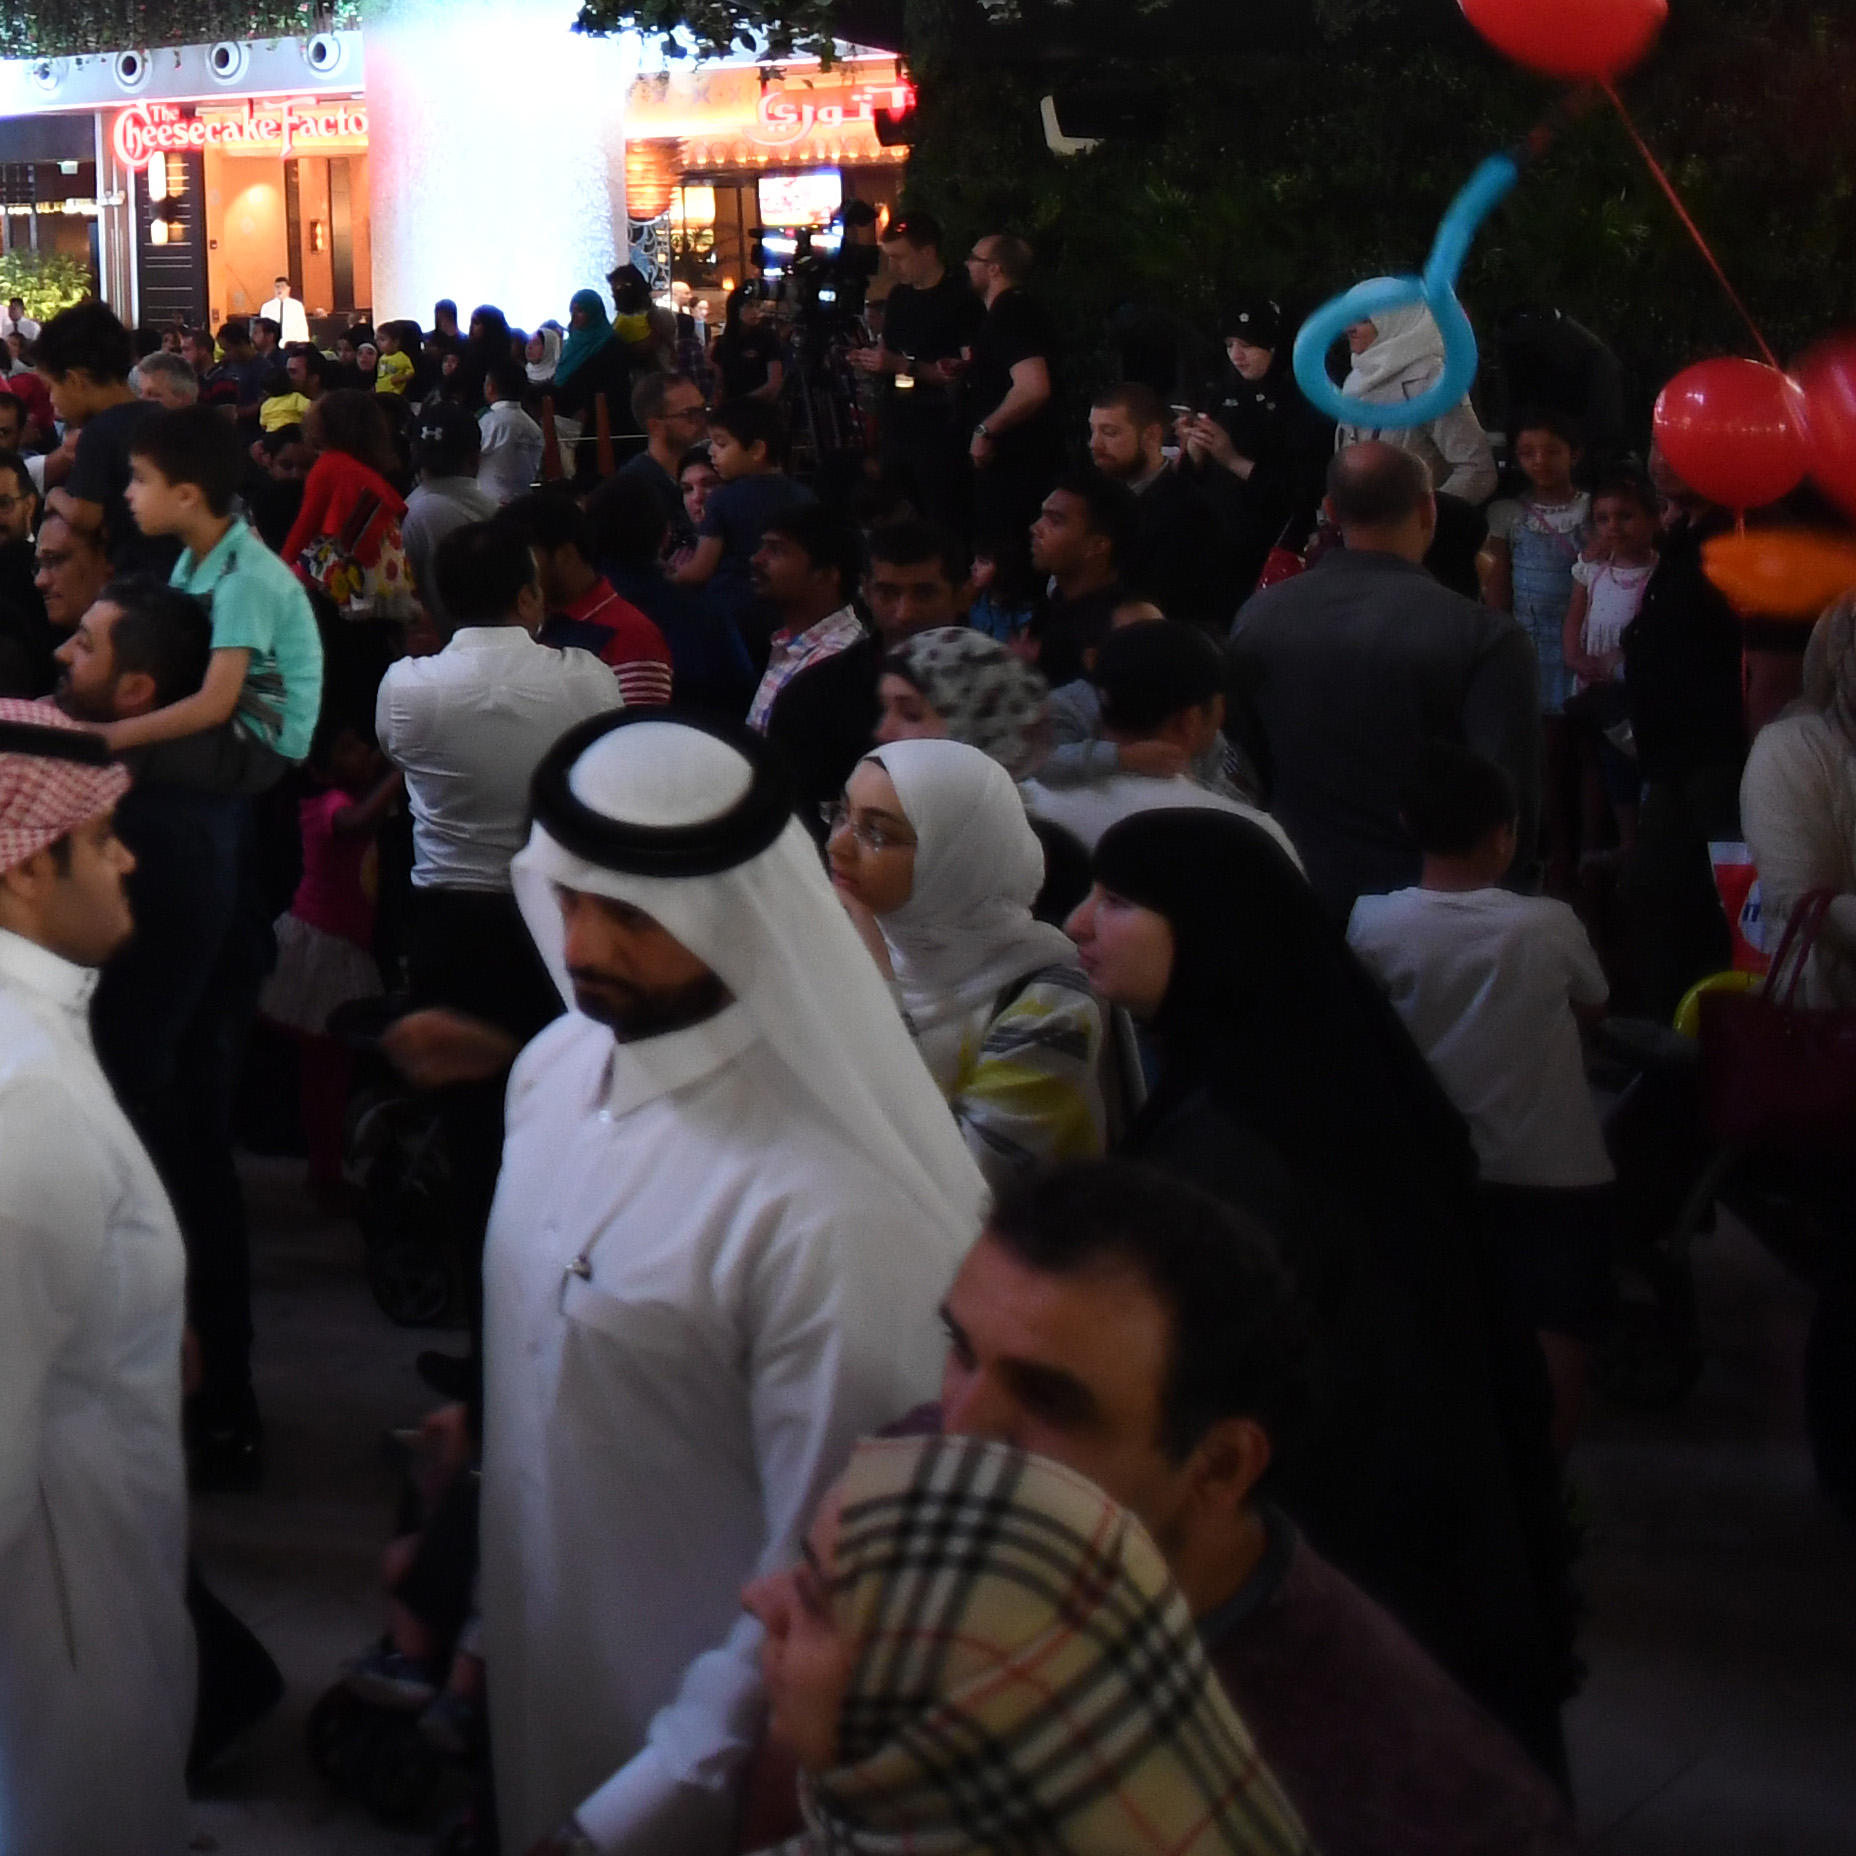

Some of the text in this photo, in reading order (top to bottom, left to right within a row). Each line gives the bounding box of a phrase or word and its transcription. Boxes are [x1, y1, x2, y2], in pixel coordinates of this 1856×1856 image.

[113, 96, 370, 168] Cheesecake Facto
[149, 102, 179, 122] The
